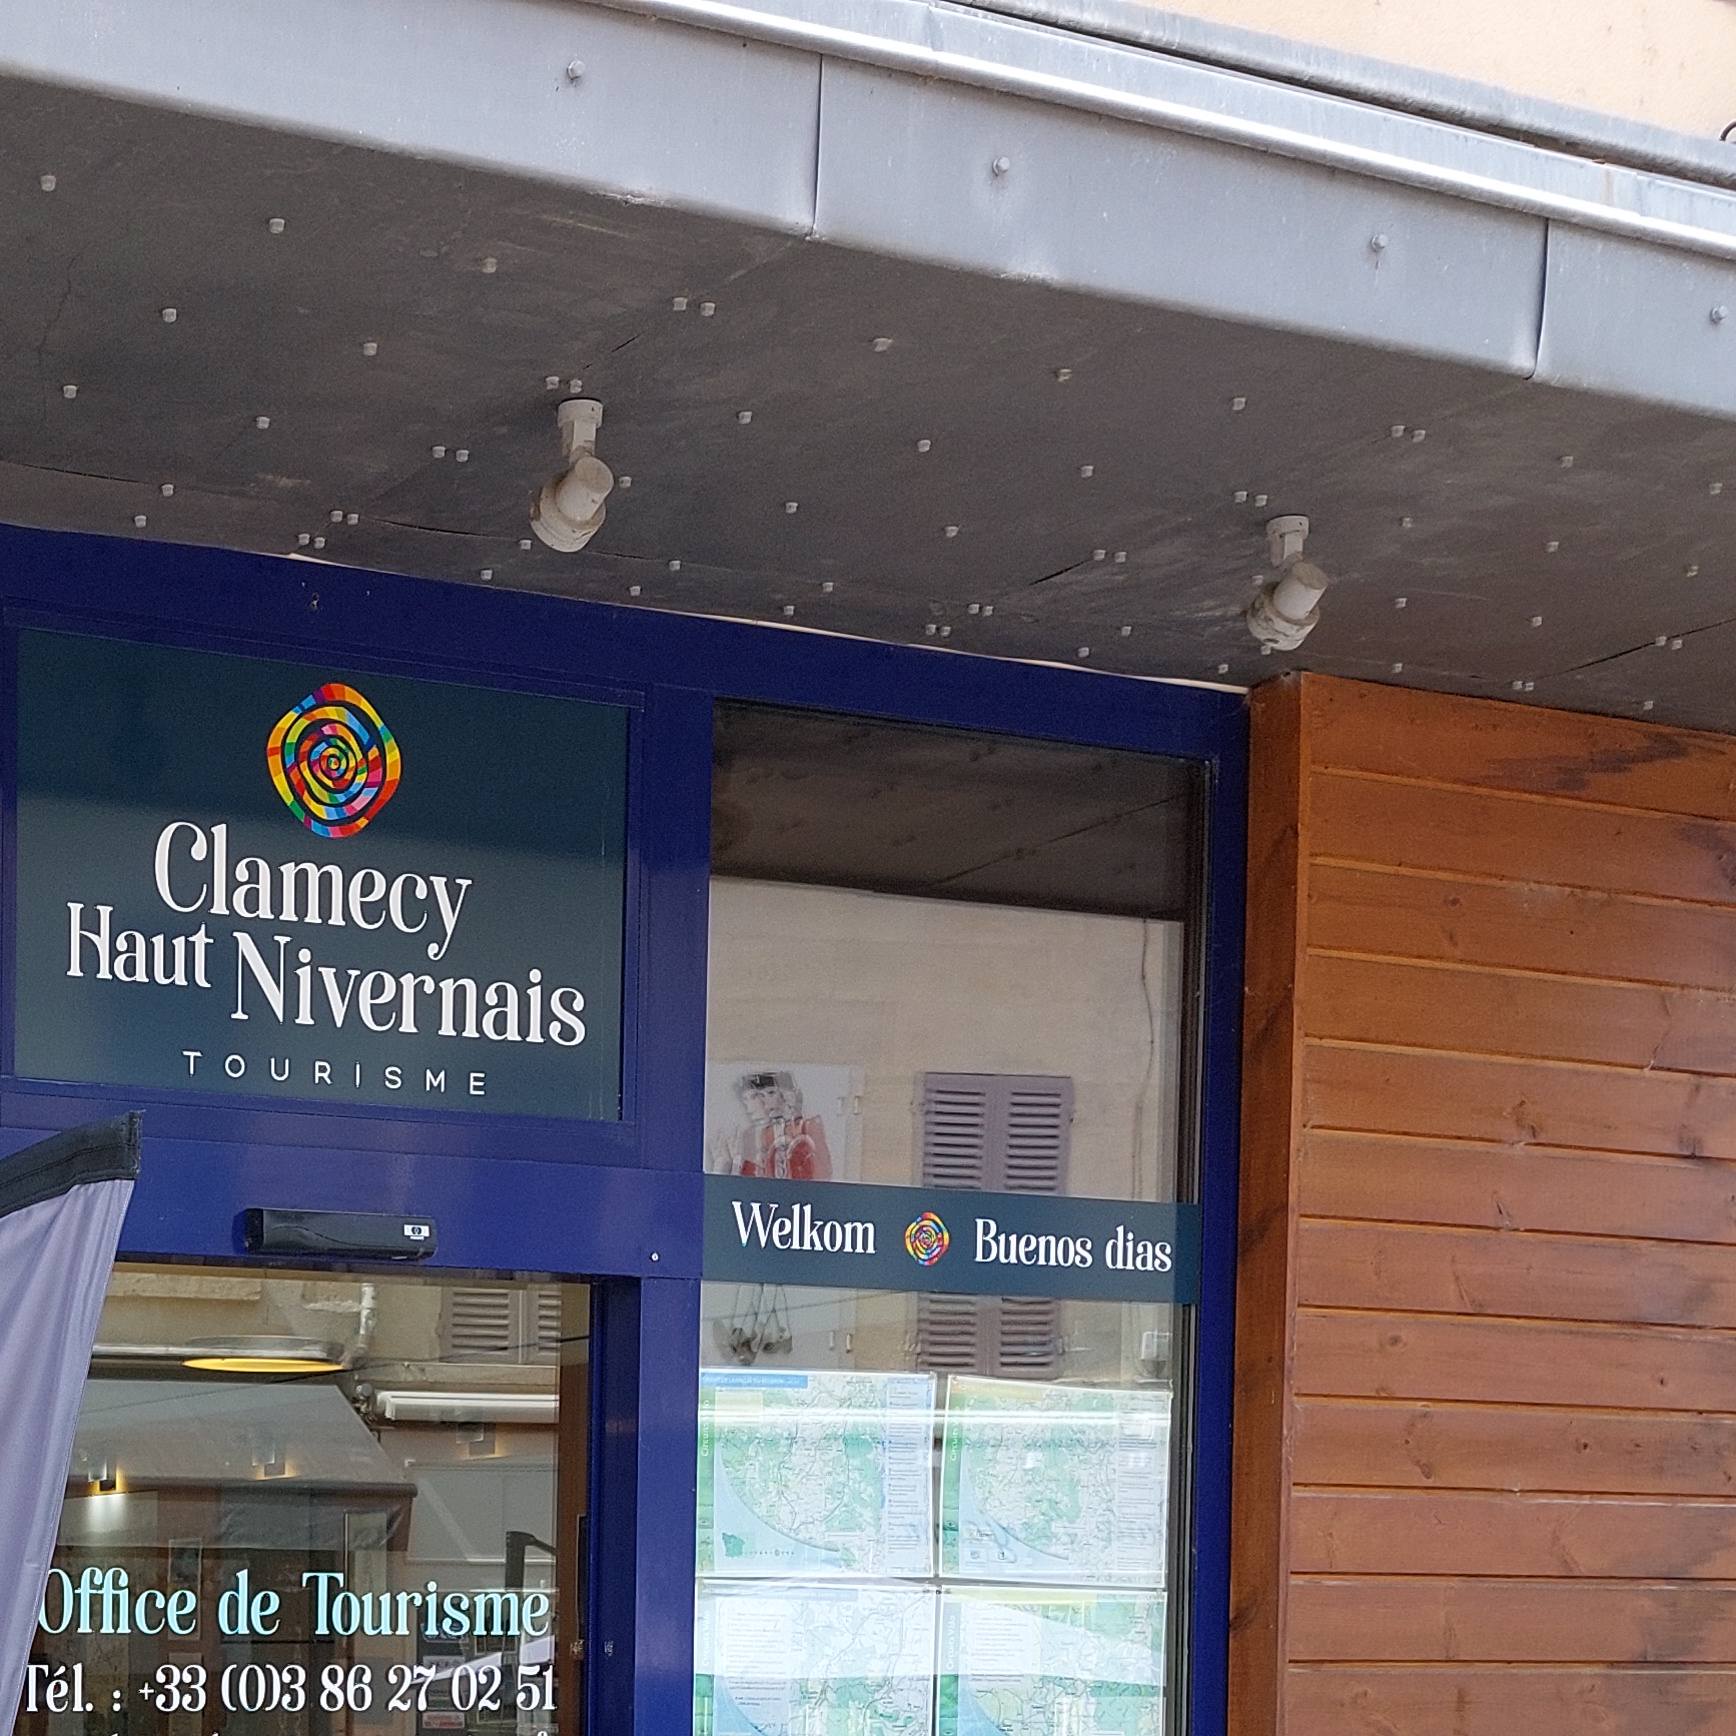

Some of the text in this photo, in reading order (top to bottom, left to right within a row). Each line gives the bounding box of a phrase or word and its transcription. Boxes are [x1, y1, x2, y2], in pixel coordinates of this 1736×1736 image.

[155, 821, 472, 961] Clamecy
[66, 902, 586, 1046] Haut Nivernais
[182, 1051, 486, 1096] TOURISME
[732, 1201, 876, 1254] Welkom
[974, 1219, 1171, 1272] Buenos dias
[39, 1567, 550, 1637] Office de Tourisme
[26, 1664, 558, 1713] Tél. : +33 (0)3 86 27 02 51
